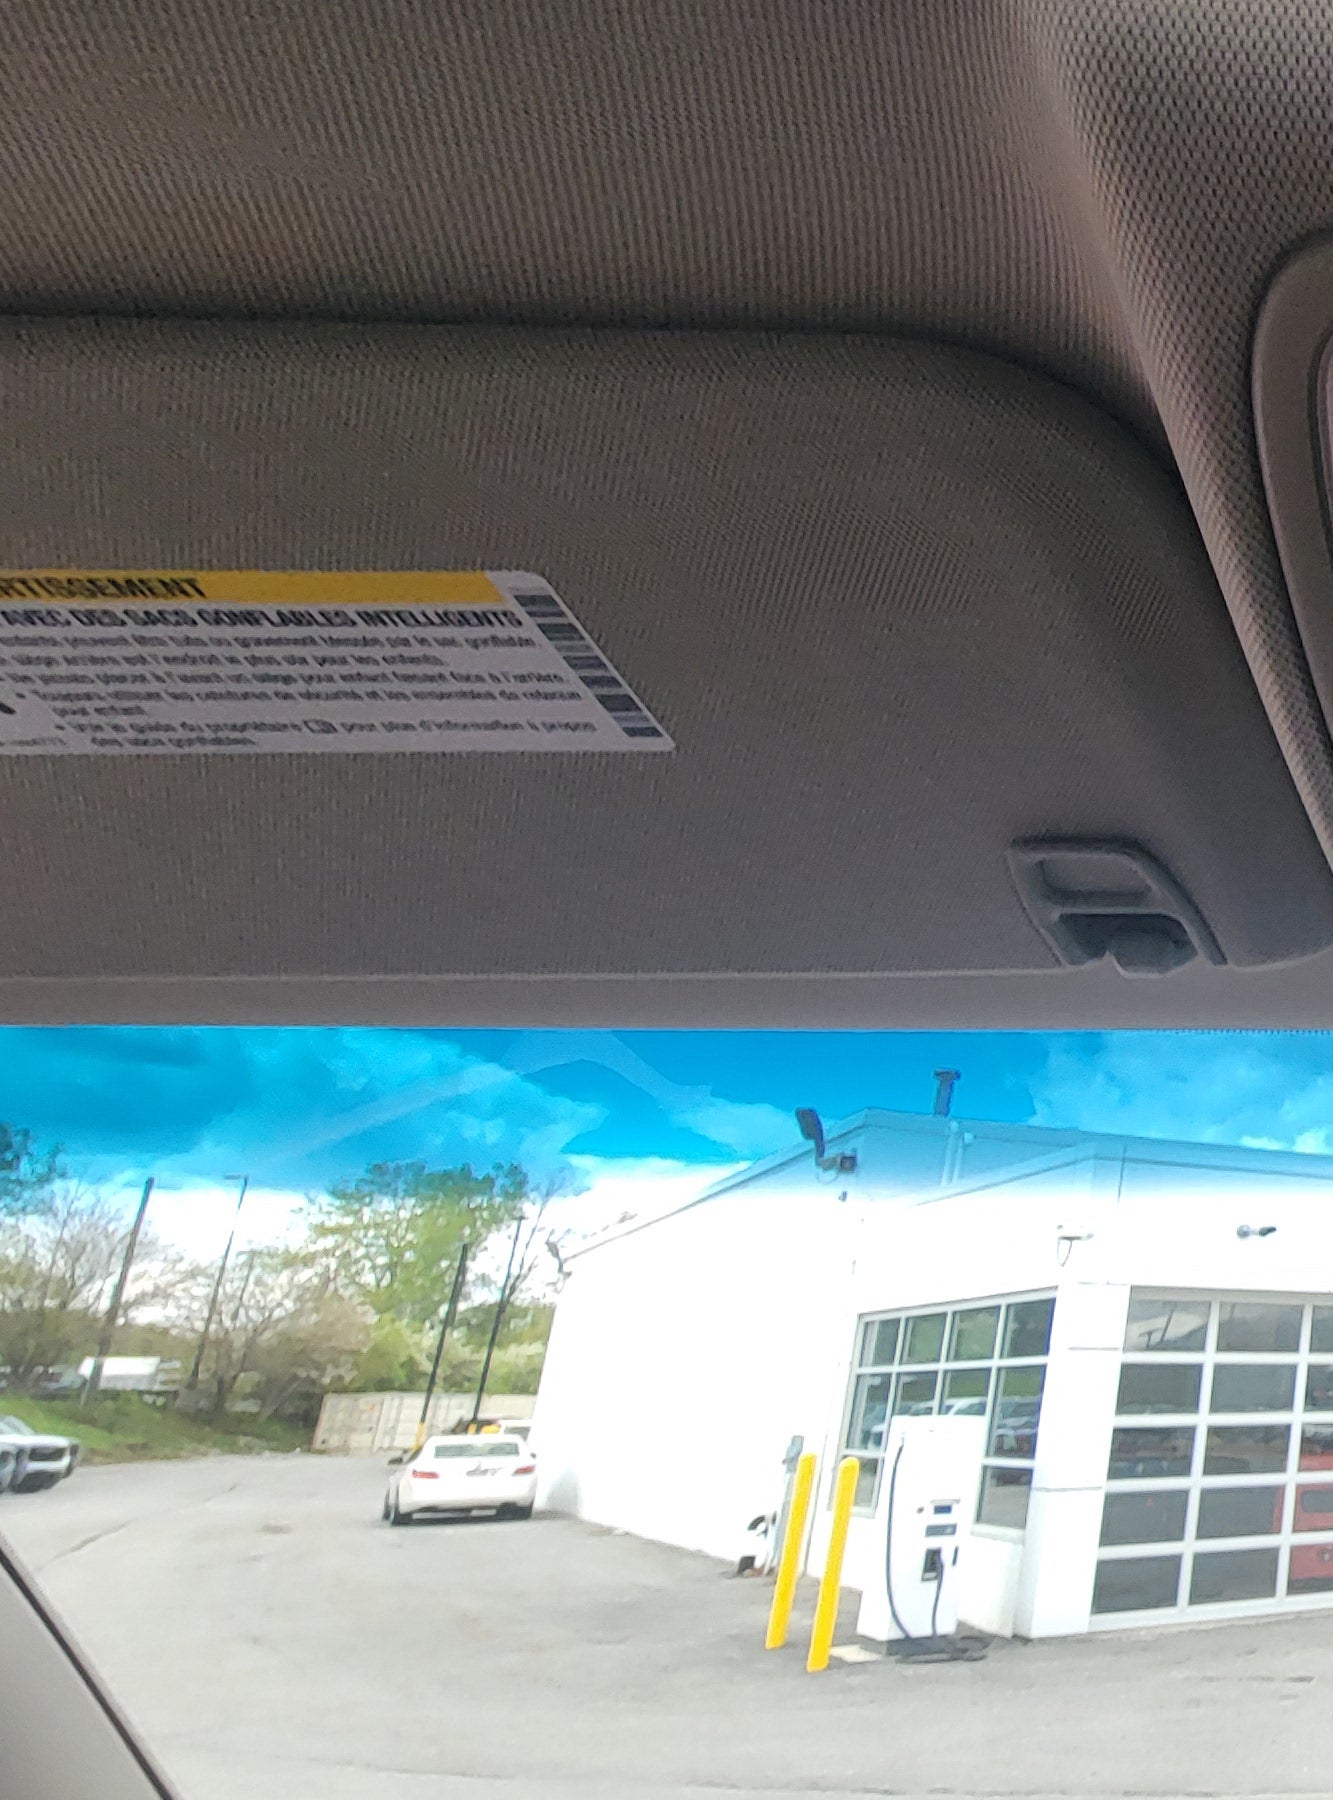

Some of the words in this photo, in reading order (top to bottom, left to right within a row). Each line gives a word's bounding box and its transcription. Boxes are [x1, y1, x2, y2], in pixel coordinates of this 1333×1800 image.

[68, 608, 128, 627] DES
[122, 608, 198, 628] SACS
[195, 608, 357, 628] GONFLABLES
[354, 609, 523, 628] INTELLIGENTS
